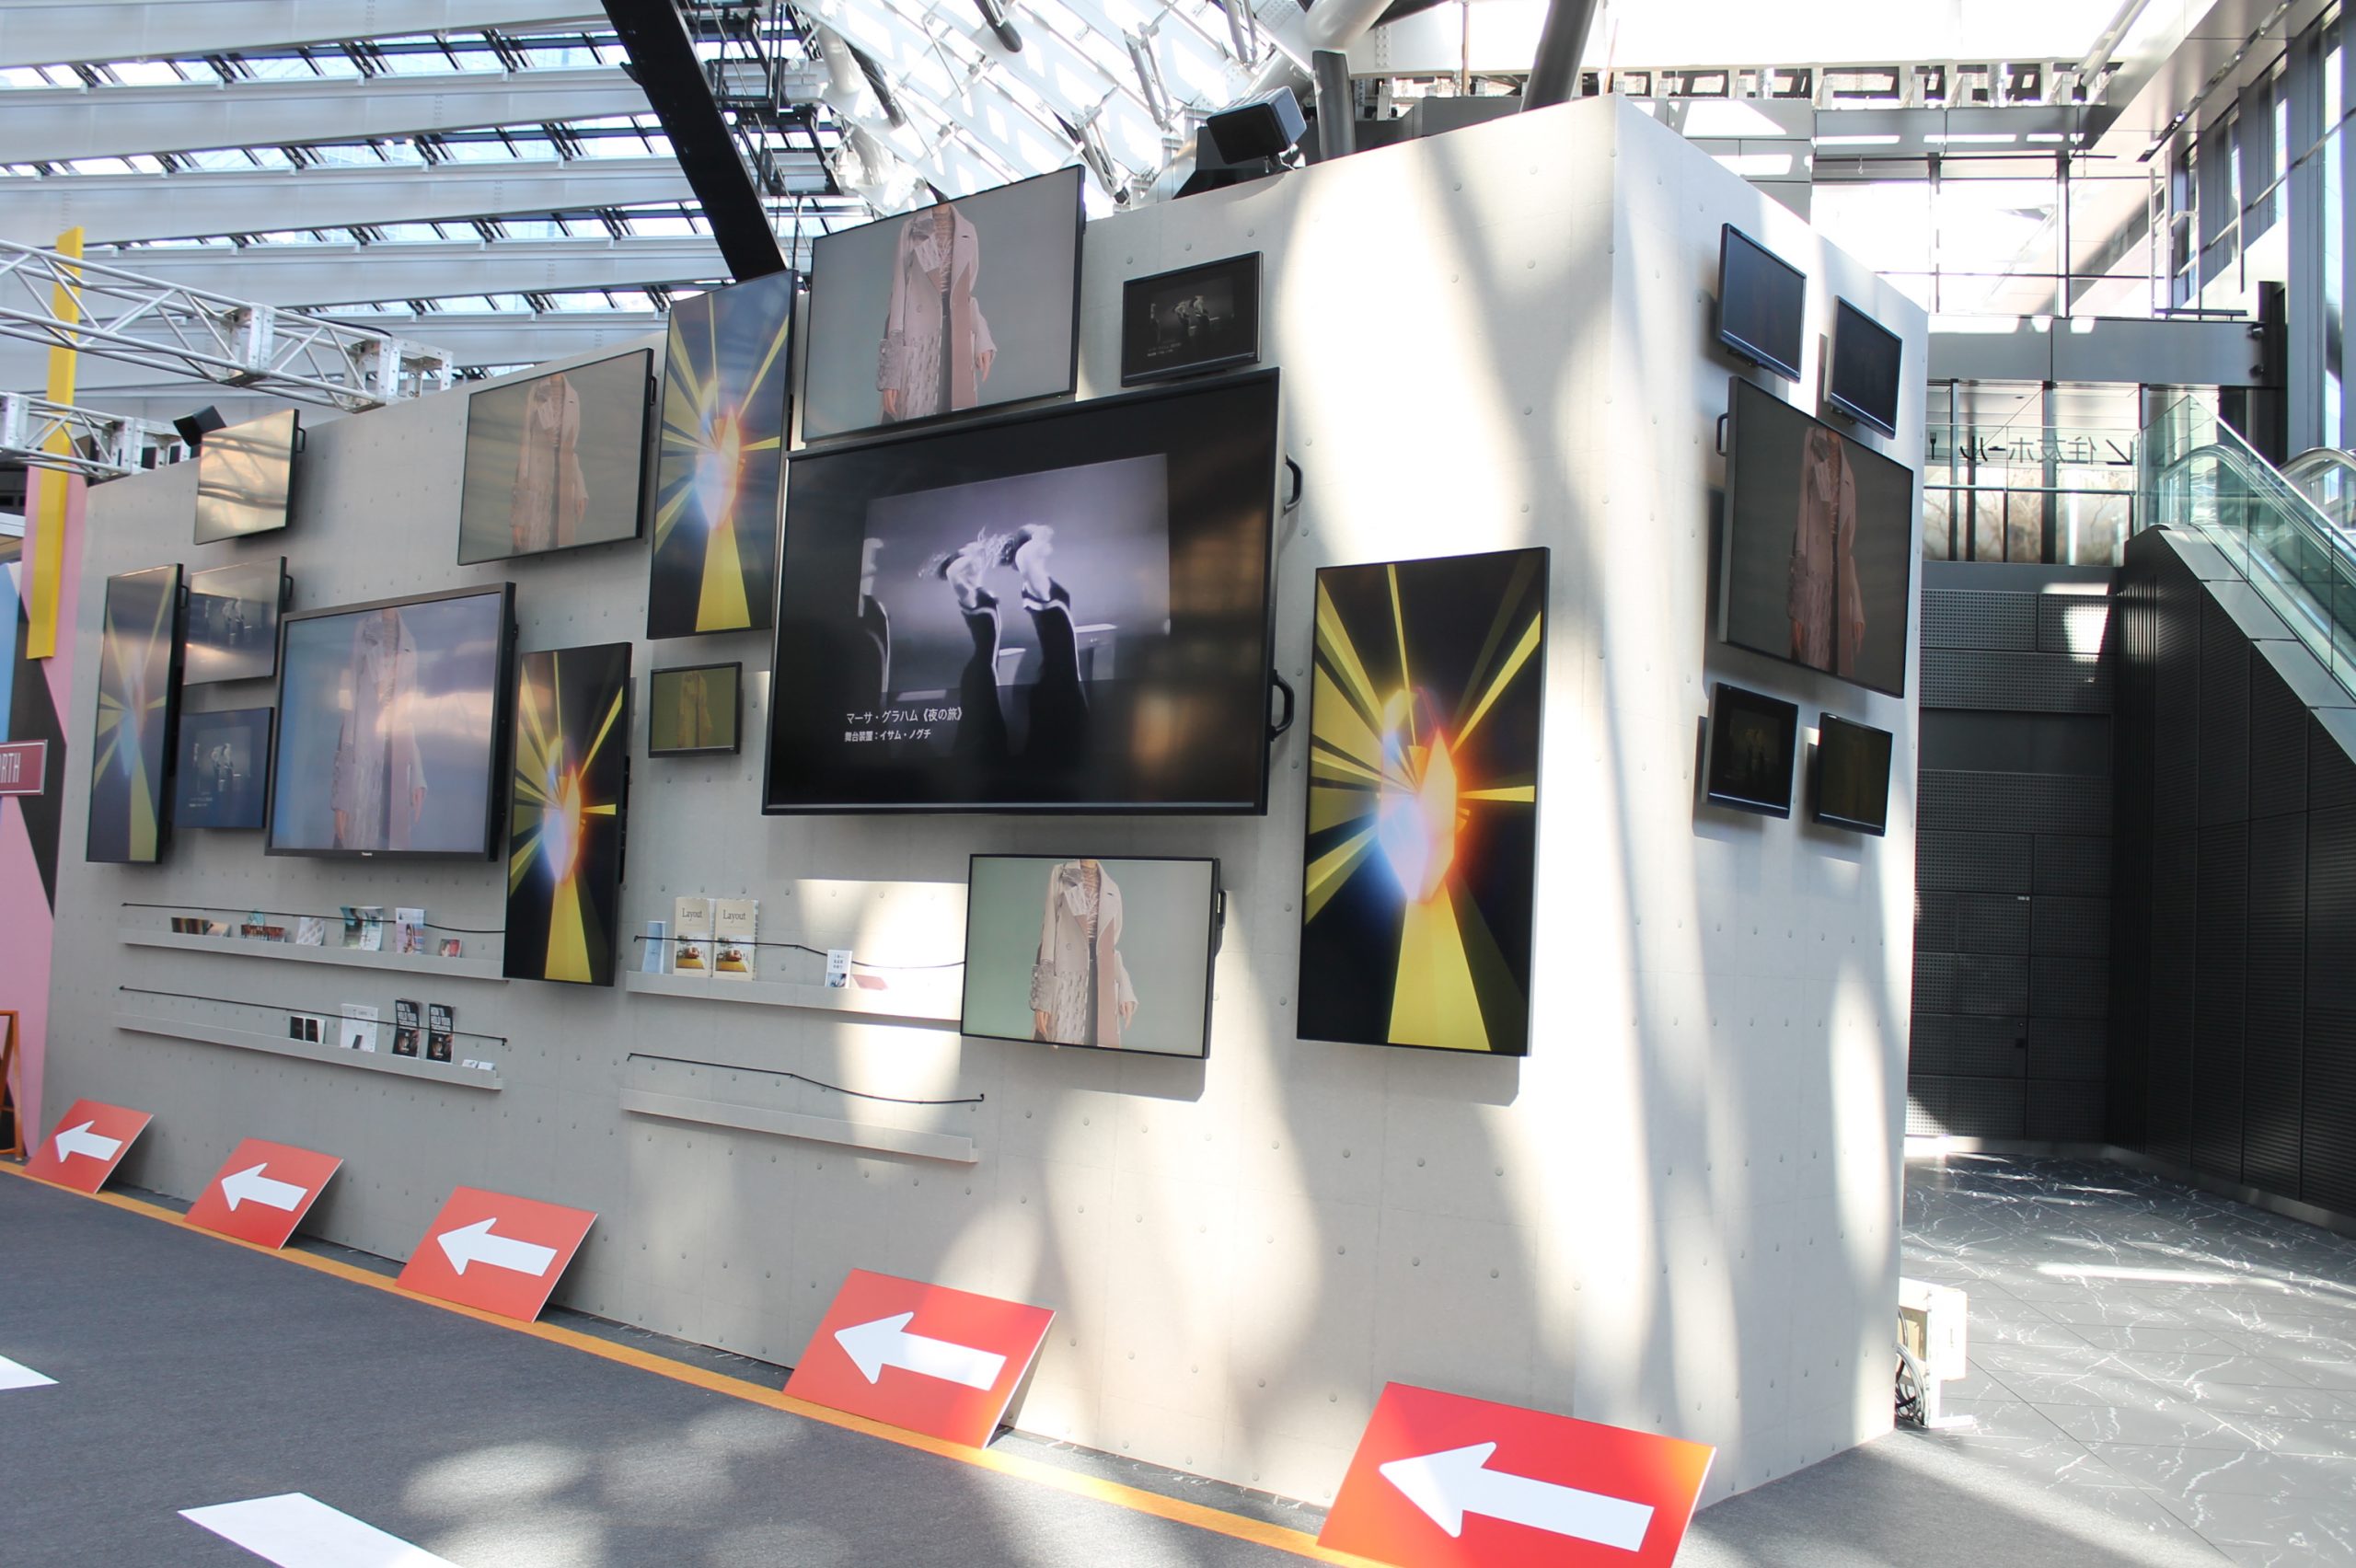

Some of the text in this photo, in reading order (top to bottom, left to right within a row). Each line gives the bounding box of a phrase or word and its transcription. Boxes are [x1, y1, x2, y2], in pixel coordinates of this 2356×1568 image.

[0, 752, 21, 783] RTH
[682, 907, 702, 921] Layout
[722, 909, 746, 923] Layout
